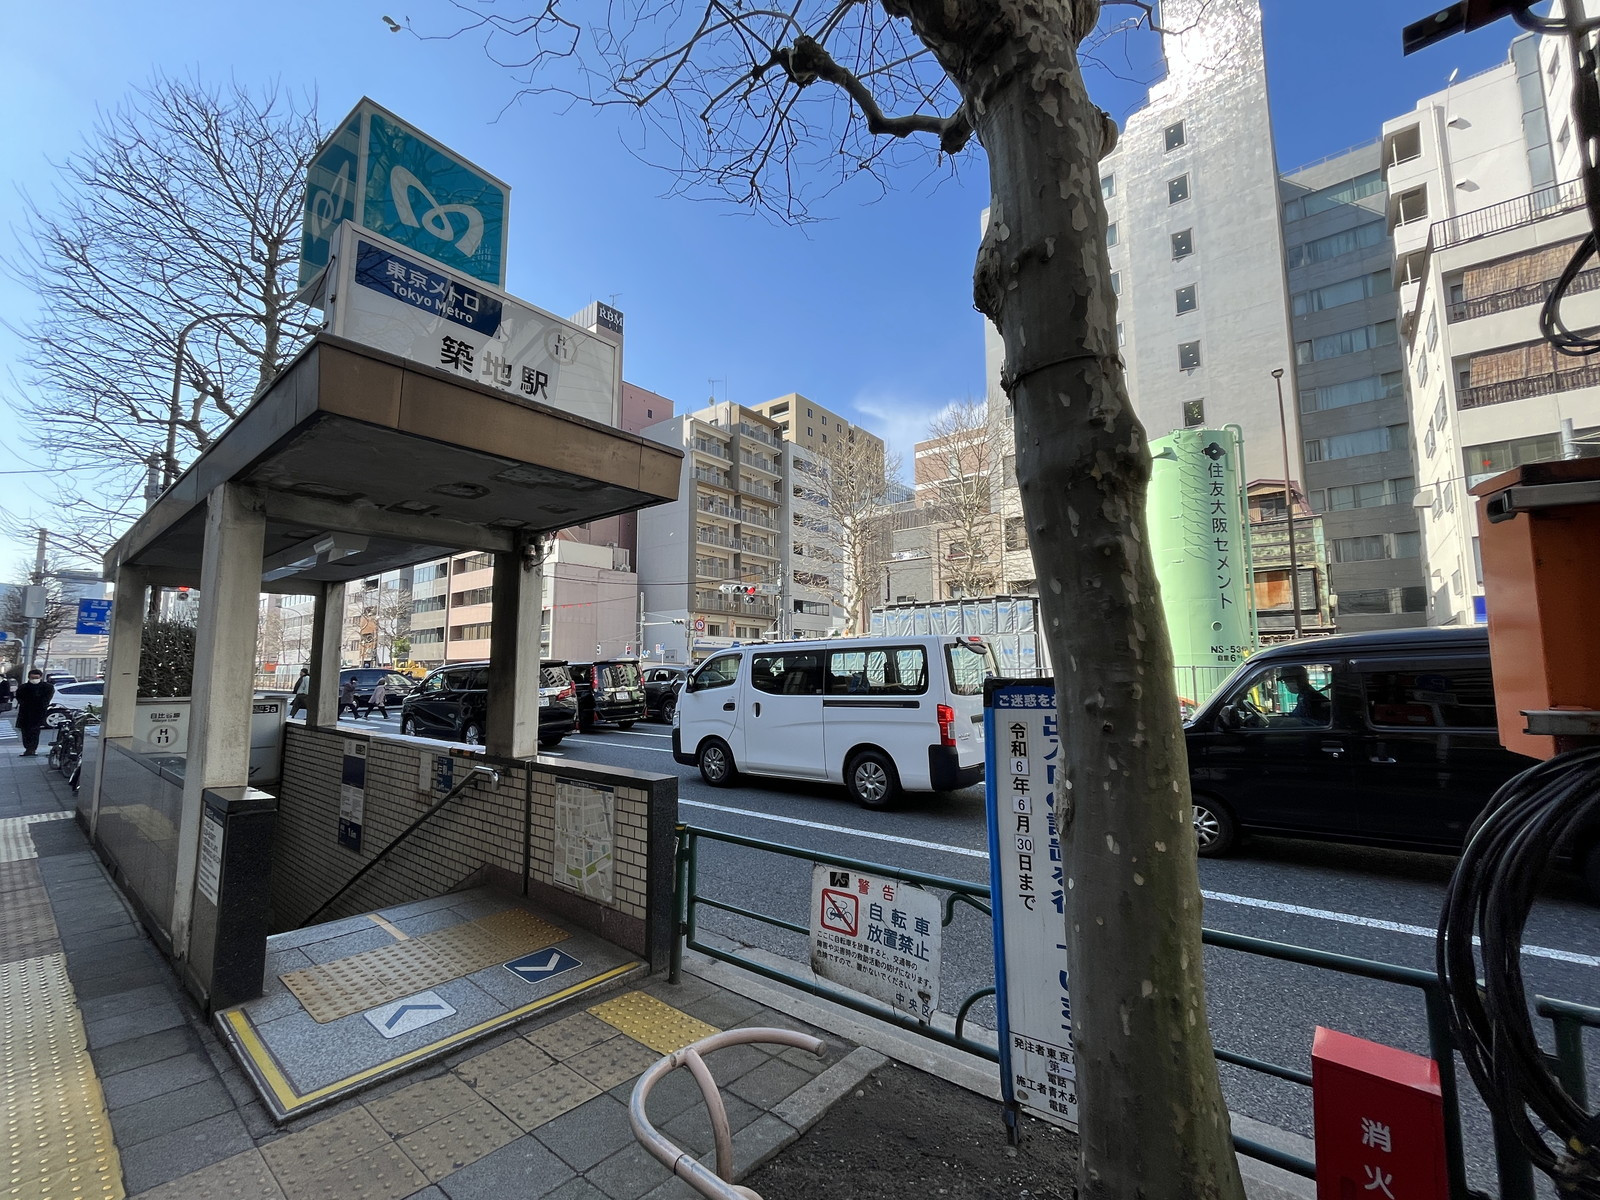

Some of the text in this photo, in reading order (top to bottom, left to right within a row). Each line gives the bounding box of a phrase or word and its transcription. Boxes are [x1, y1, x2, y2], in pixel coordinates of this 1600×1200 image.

[386, 259, 479, 312] 東京メトロ
[391, 280, 473, 324] Tokyo Metro
[599, 306, 623, 327] RBM
[440, 335, 549, 401] 築地駅
[554, 344, 568, 359] 11
[1208, 462, 1233, 609] 住友大阪セメント
[1009, 722, 1037, 911] 令和6年6月30日まで
[858, 878, 894, 901] 警告
[869, 902, 931, 937] 自転車
[867, 922, 930, 962] 放置禁止
[895, 992, 931, 1018] 中央区
[1048, 1073, 1067, 1088] 電話
[1048, 1099, 1069, 1115] 電話
[1361, 1117, 1395, 1200] 消火
